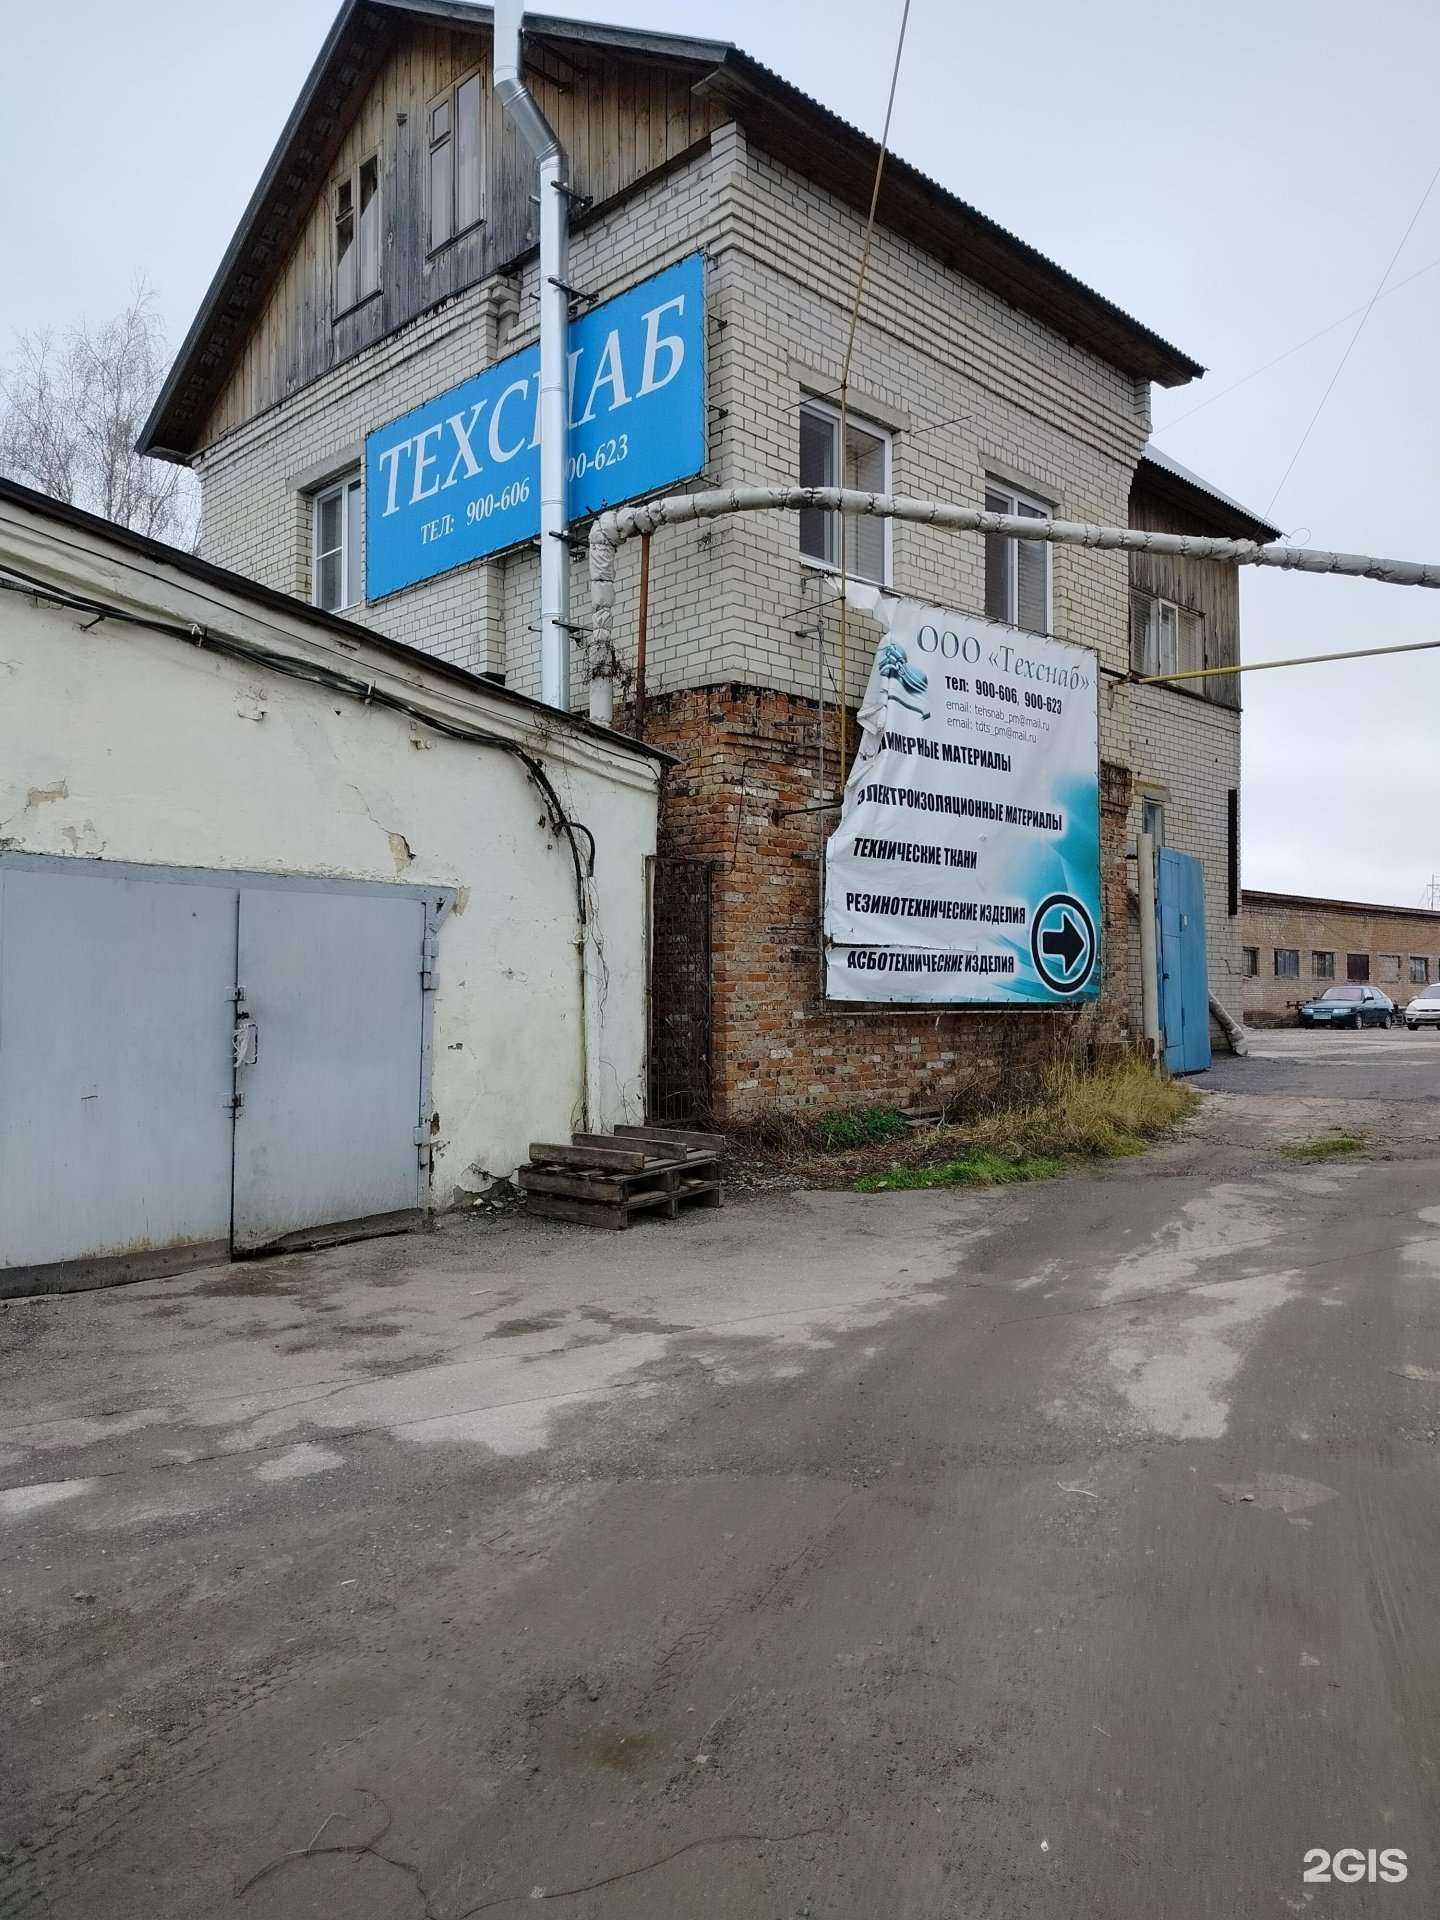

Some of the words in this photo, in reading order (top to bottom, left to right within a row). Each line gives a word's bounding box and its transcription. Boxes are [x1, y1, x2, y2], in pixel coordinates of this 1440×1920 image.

[420, 516, 455, 546] ТЕЛ:
[466, 477, 530, 527] 900-606
[565, 433, 629, 482] 00-623
[916, 625, 981, 664] ООО
[988, 645, 1091, 691] «Техснаб»
[945, 675, 970, 693] тел:
[975, 679, 1020, 706] 900-606,
[1025, 691, 1063, 715] 900-623
[946, 700, 971, 714] email:
[974, 703, 1050, 732] tehsnab_pm@mail.ru
[947, 718, 973, 730] email:
[975, 720, 1037, 744] tdts_pm@mail.ru
[942, 743, 1012, 773] МАТЕРИАЛЫ
[857, 783, 1003, 823] ЭЛЕКТРОИЗОЛЯЦИОННЫЕ
[1005, 808, 1063, 832] МАТЕРИАЛЫ
[853, 837, 942, 866] ТЕХНИЧЕСКИЕ
[944, 848, 978, 869] ТКАНИ
[846, 892, 978, 922] РЕЗИНОТЕХНИЧЕСКИЕ
[979, 903, 1026, 925] ИЗДЕЛИЯ
[847, 950, 963, 973] АСБОТЕХНИЧЕСКИЕ
[964, 954, 1015, 976] ИЗДЕЛИЯ
